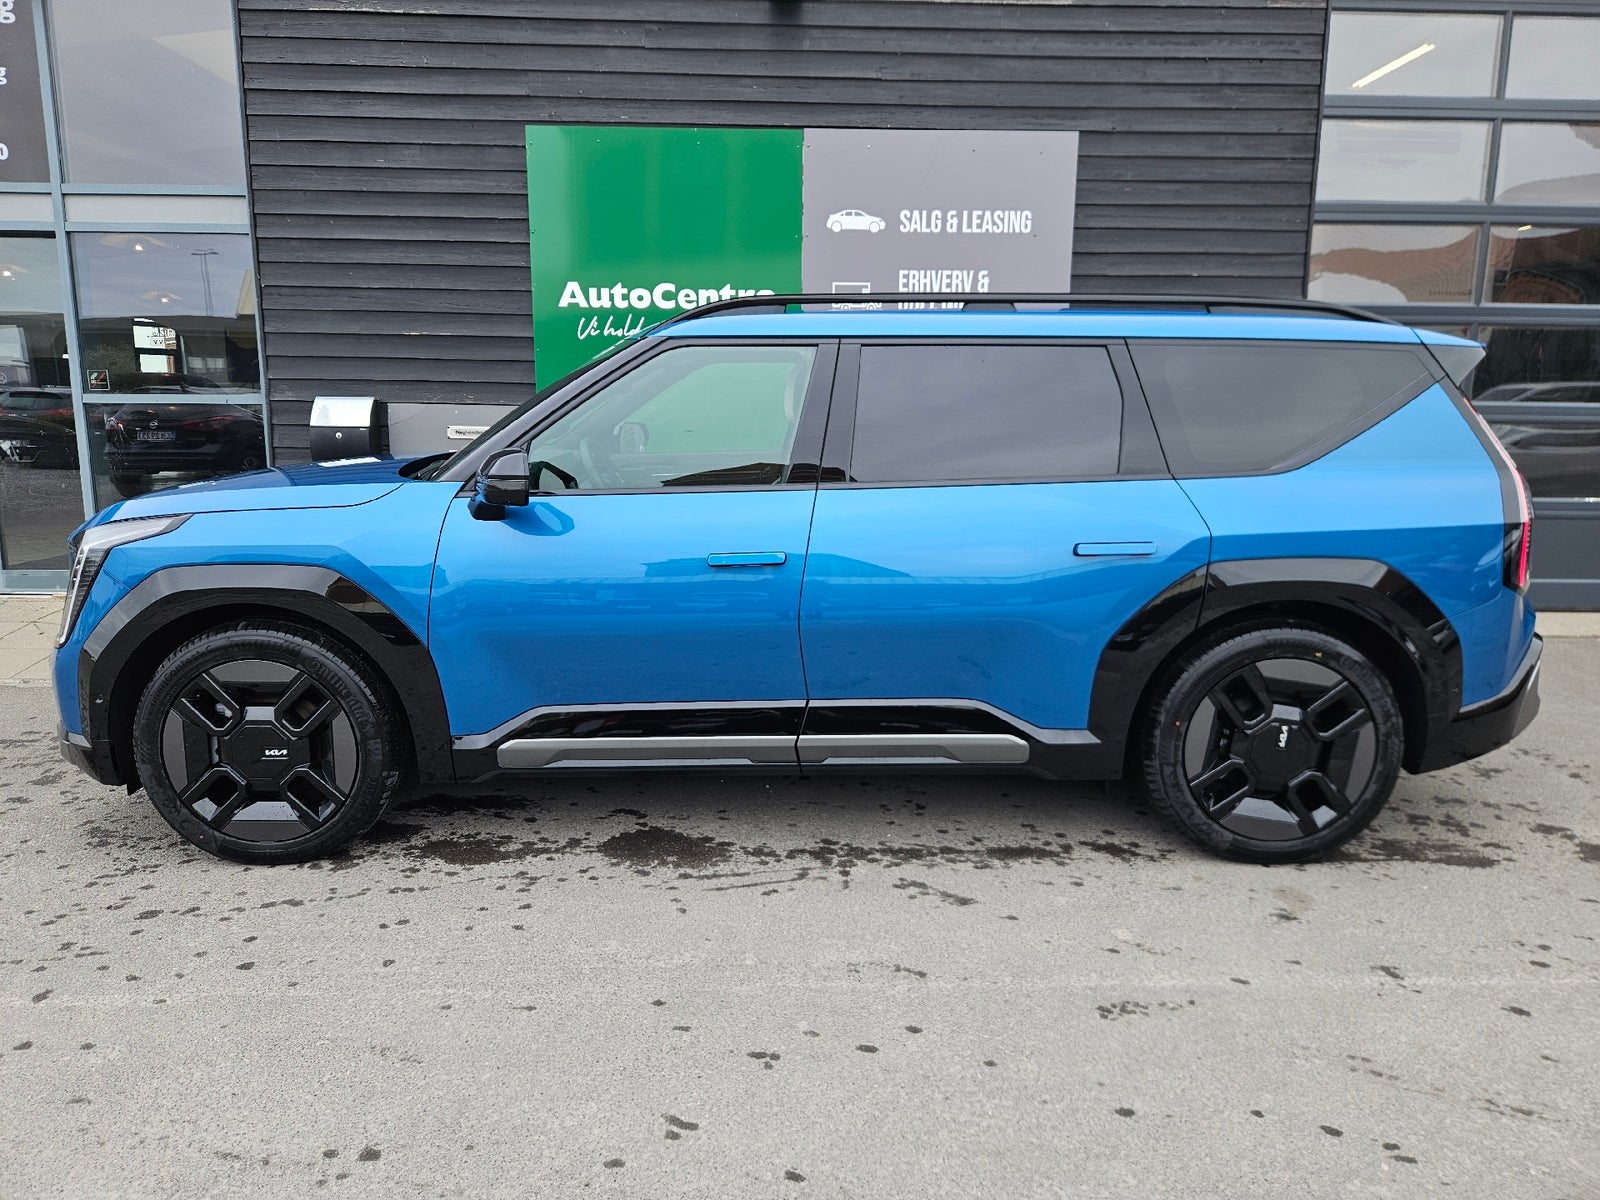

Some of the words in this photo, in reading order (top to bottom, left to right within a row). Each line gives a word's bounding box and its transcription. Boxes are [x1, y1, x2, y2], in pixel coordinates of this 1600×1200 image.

[900, 210, 942, 233] SALG
[946, 210, 958, 233] &
[962, 210, 1032, 233] LEASING
[898, 269, 974, 293] ERHVERV
[977, 269, 990, 293] &
[558, 281, 775, 309] AutoCent
[577, 316, 600, 340] Vi
